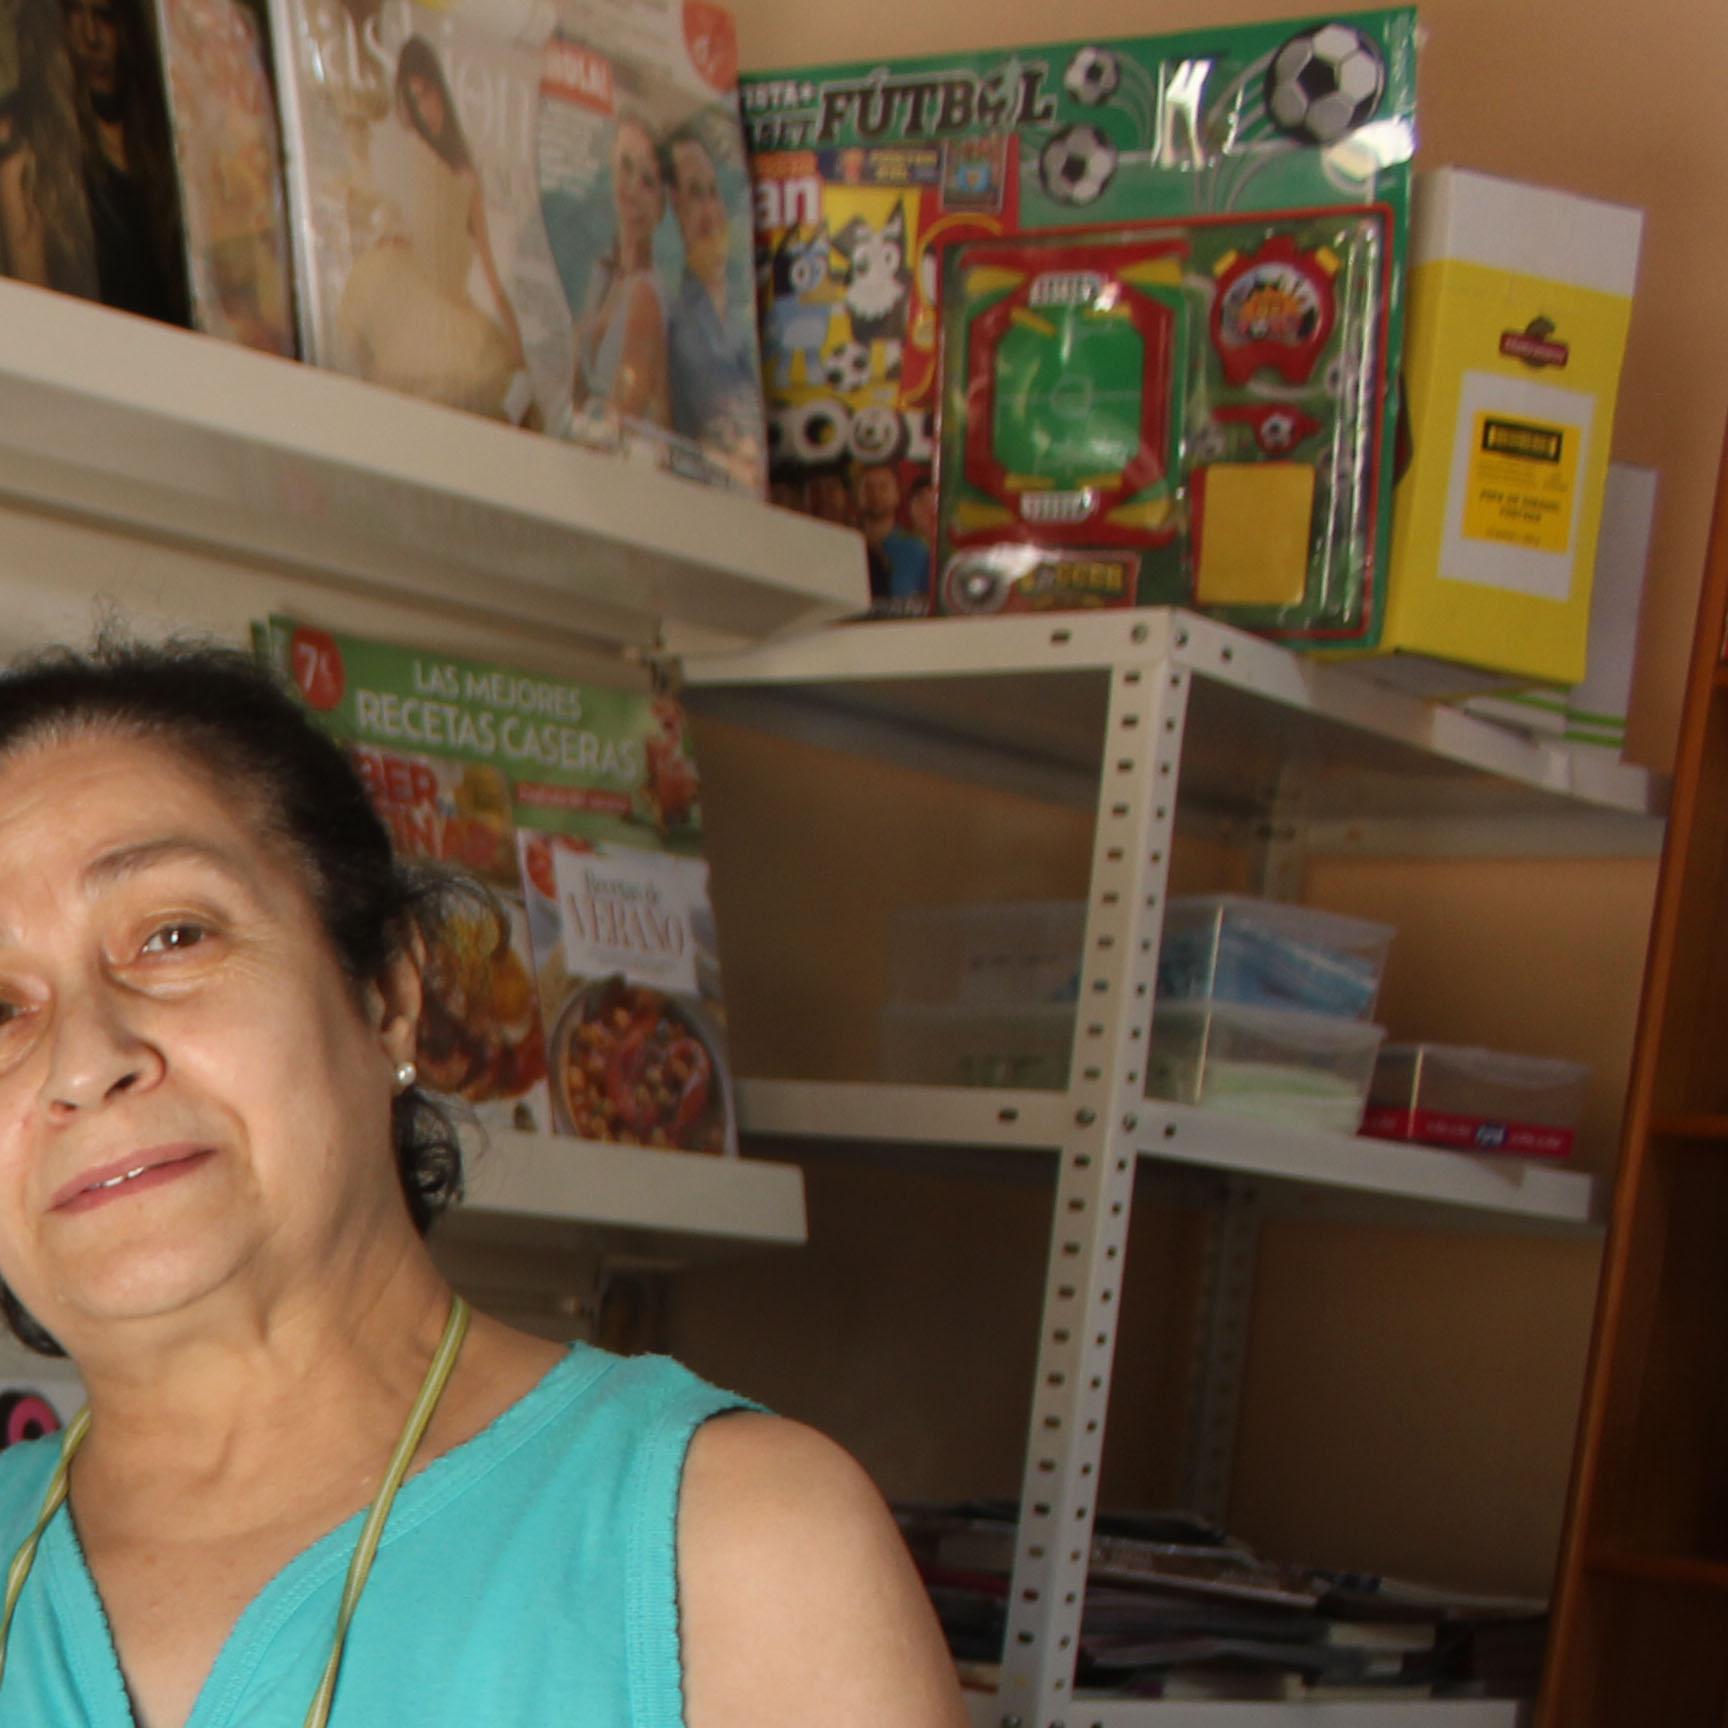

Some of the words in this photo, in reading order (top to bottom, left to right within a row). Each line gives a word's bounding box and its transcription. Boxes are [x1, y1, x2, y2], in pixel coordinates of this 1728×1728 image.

[816, 66, 1057, 142] FÚTBOL
[412, 660, 459, 693] LAS
[464, 674, 583, 721] MEJORES
[355, 689, 498, 756] RECETAS
[500, 715, 638, 780] CASERAS
[567, 893, 687, 958] VERANO
